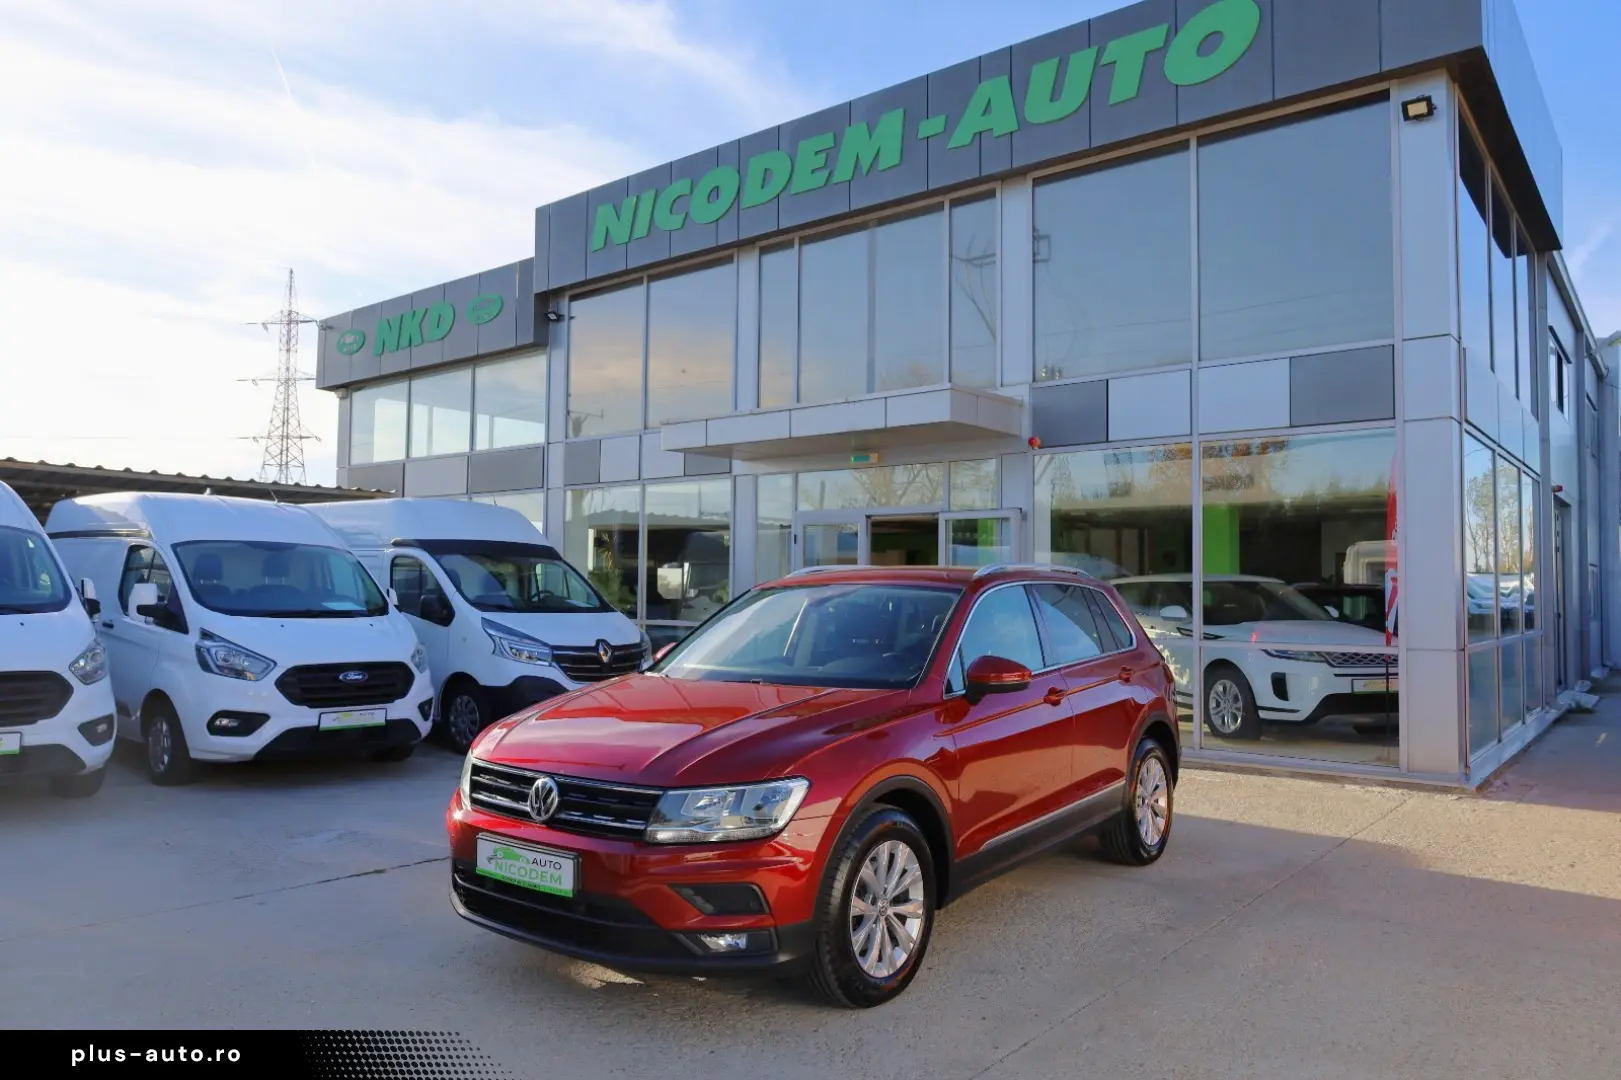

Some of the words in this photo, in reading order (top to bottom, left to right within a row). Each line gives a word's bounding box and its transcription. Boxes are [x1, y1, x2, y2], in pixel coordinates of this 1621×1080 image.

[373, 301, 455, 357] NKD
[494, 860, 562, 885] NICODEM
[531, 857, 562, 870] AUTO
